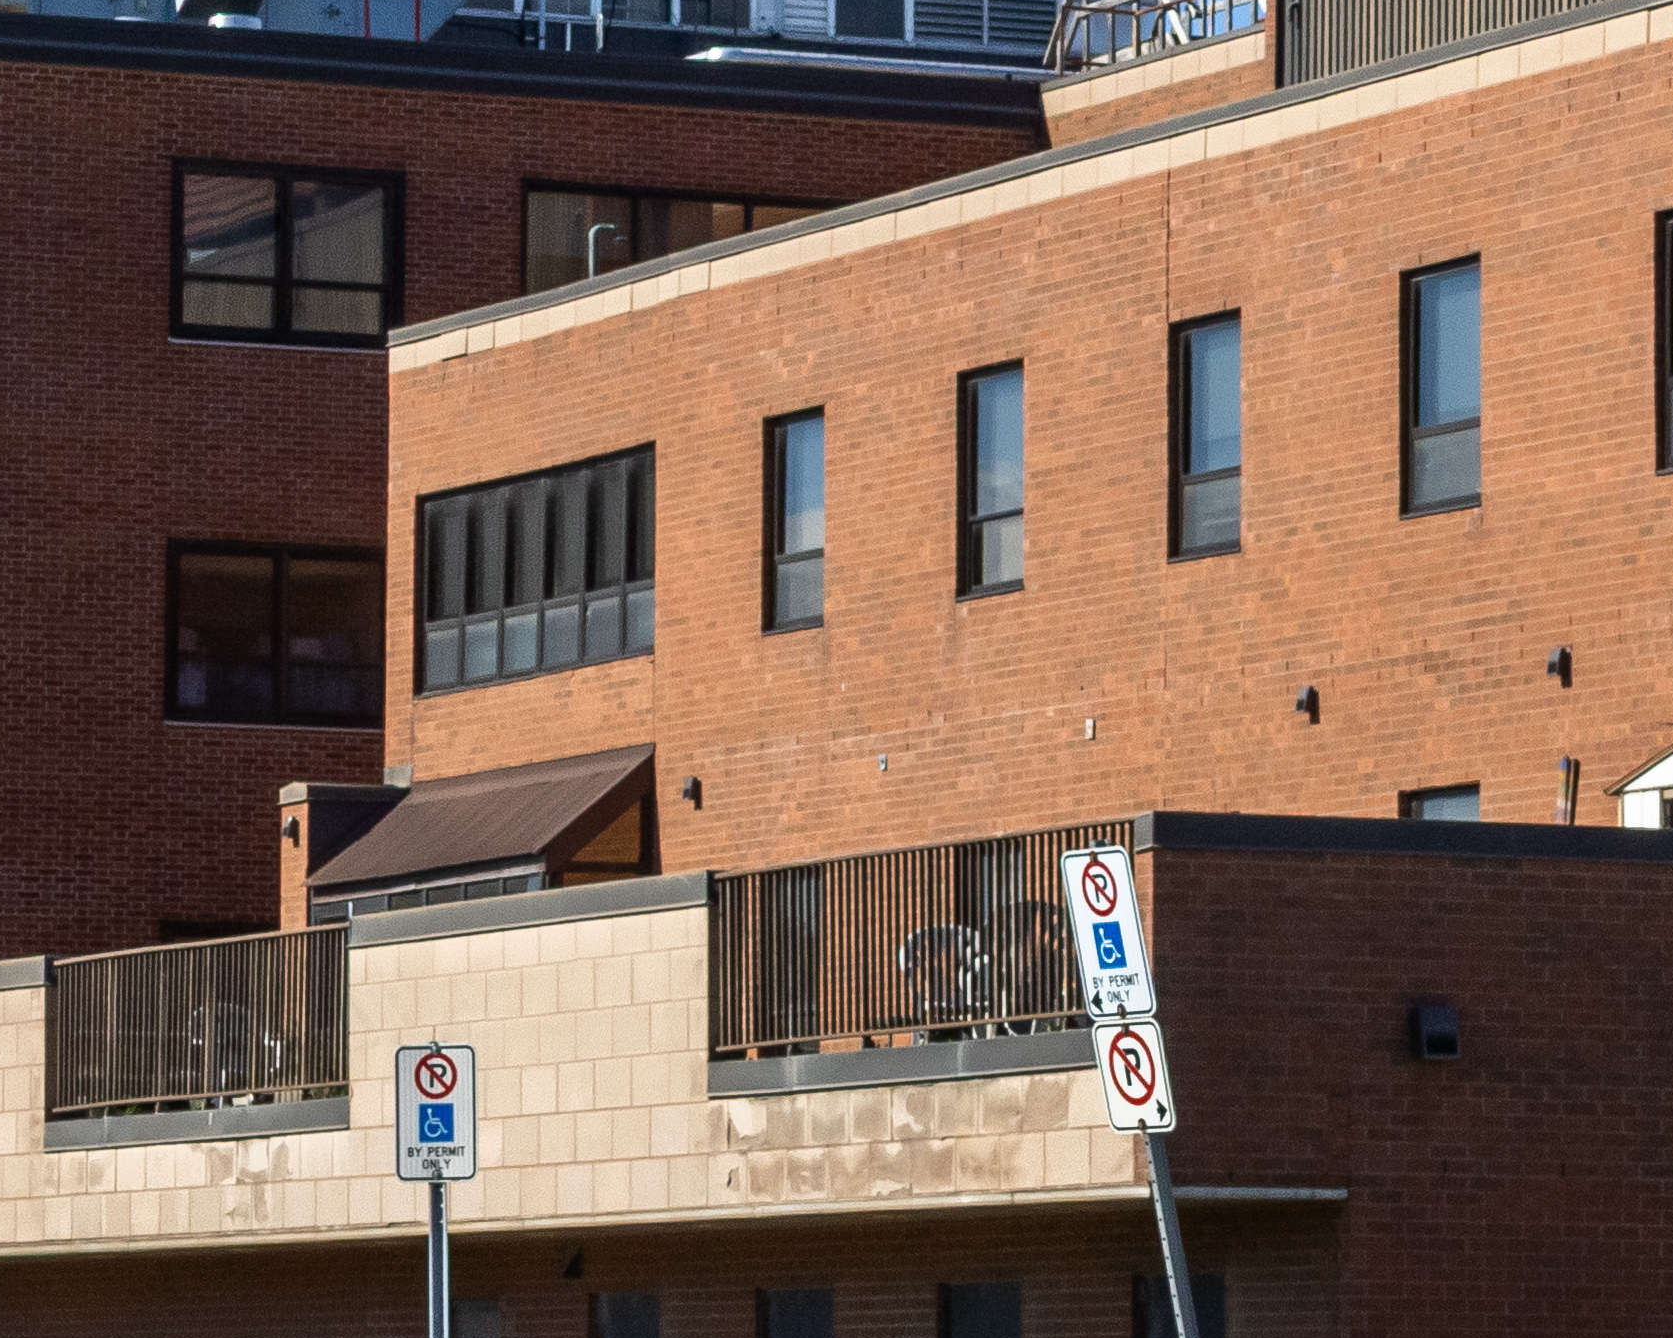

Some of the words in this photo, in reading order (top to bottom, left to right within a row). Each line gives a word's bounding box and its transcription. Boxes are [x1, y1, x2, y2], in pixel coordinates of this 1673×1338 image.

[1092, 976, 1105, 990] BY
[1108, 972, 1140, 989] PERMIT
[1106, 989, 1131, 1004] ONLY
[408, 1146, 423, 1158] BY
[428, 1146, 465, 1158] PERMIT
[422, 1159, 451, 1170] ONLY
